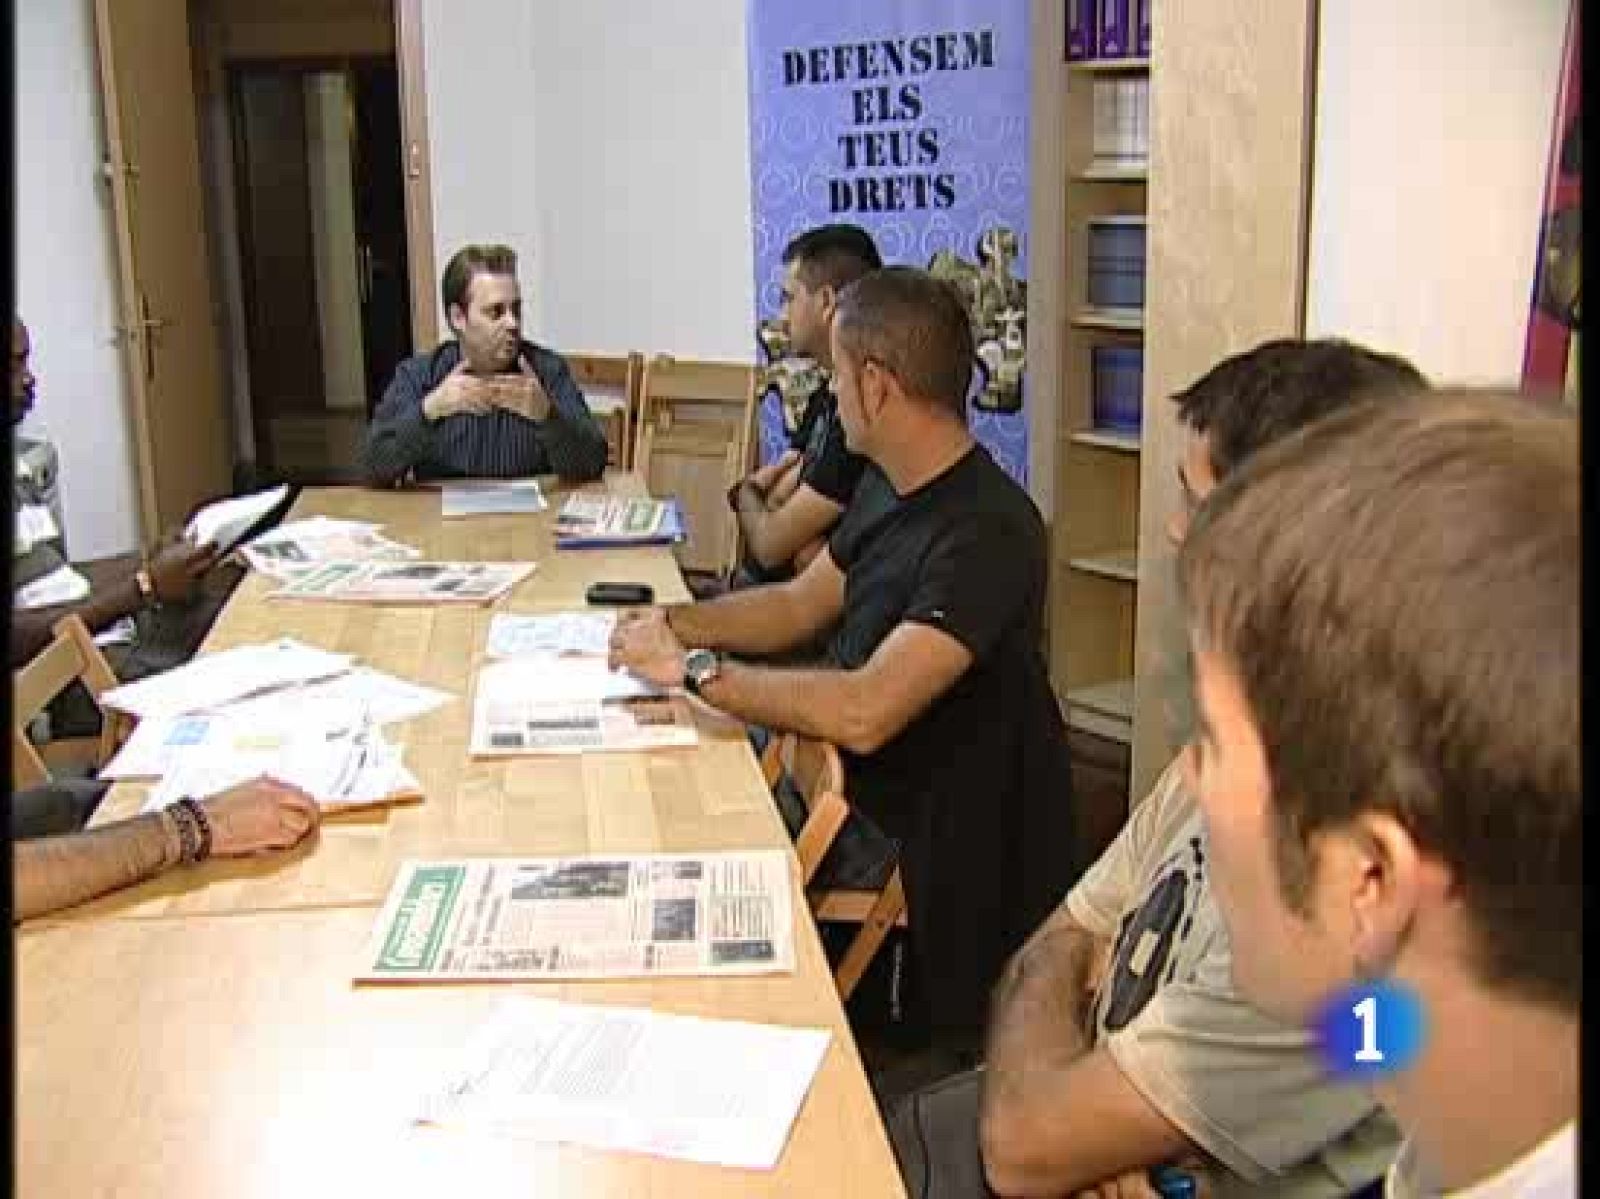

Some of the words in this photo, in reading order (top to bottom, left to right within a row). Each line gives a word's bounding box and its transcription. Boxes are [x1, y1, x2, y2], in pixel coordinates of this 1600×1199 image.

[782, 30, 994, 86] DEFENSEM
[852, 84, 923, 125] ELS
[837, 128, 940, 169] TEUS
[828, 174, 955, 213] DRETS
